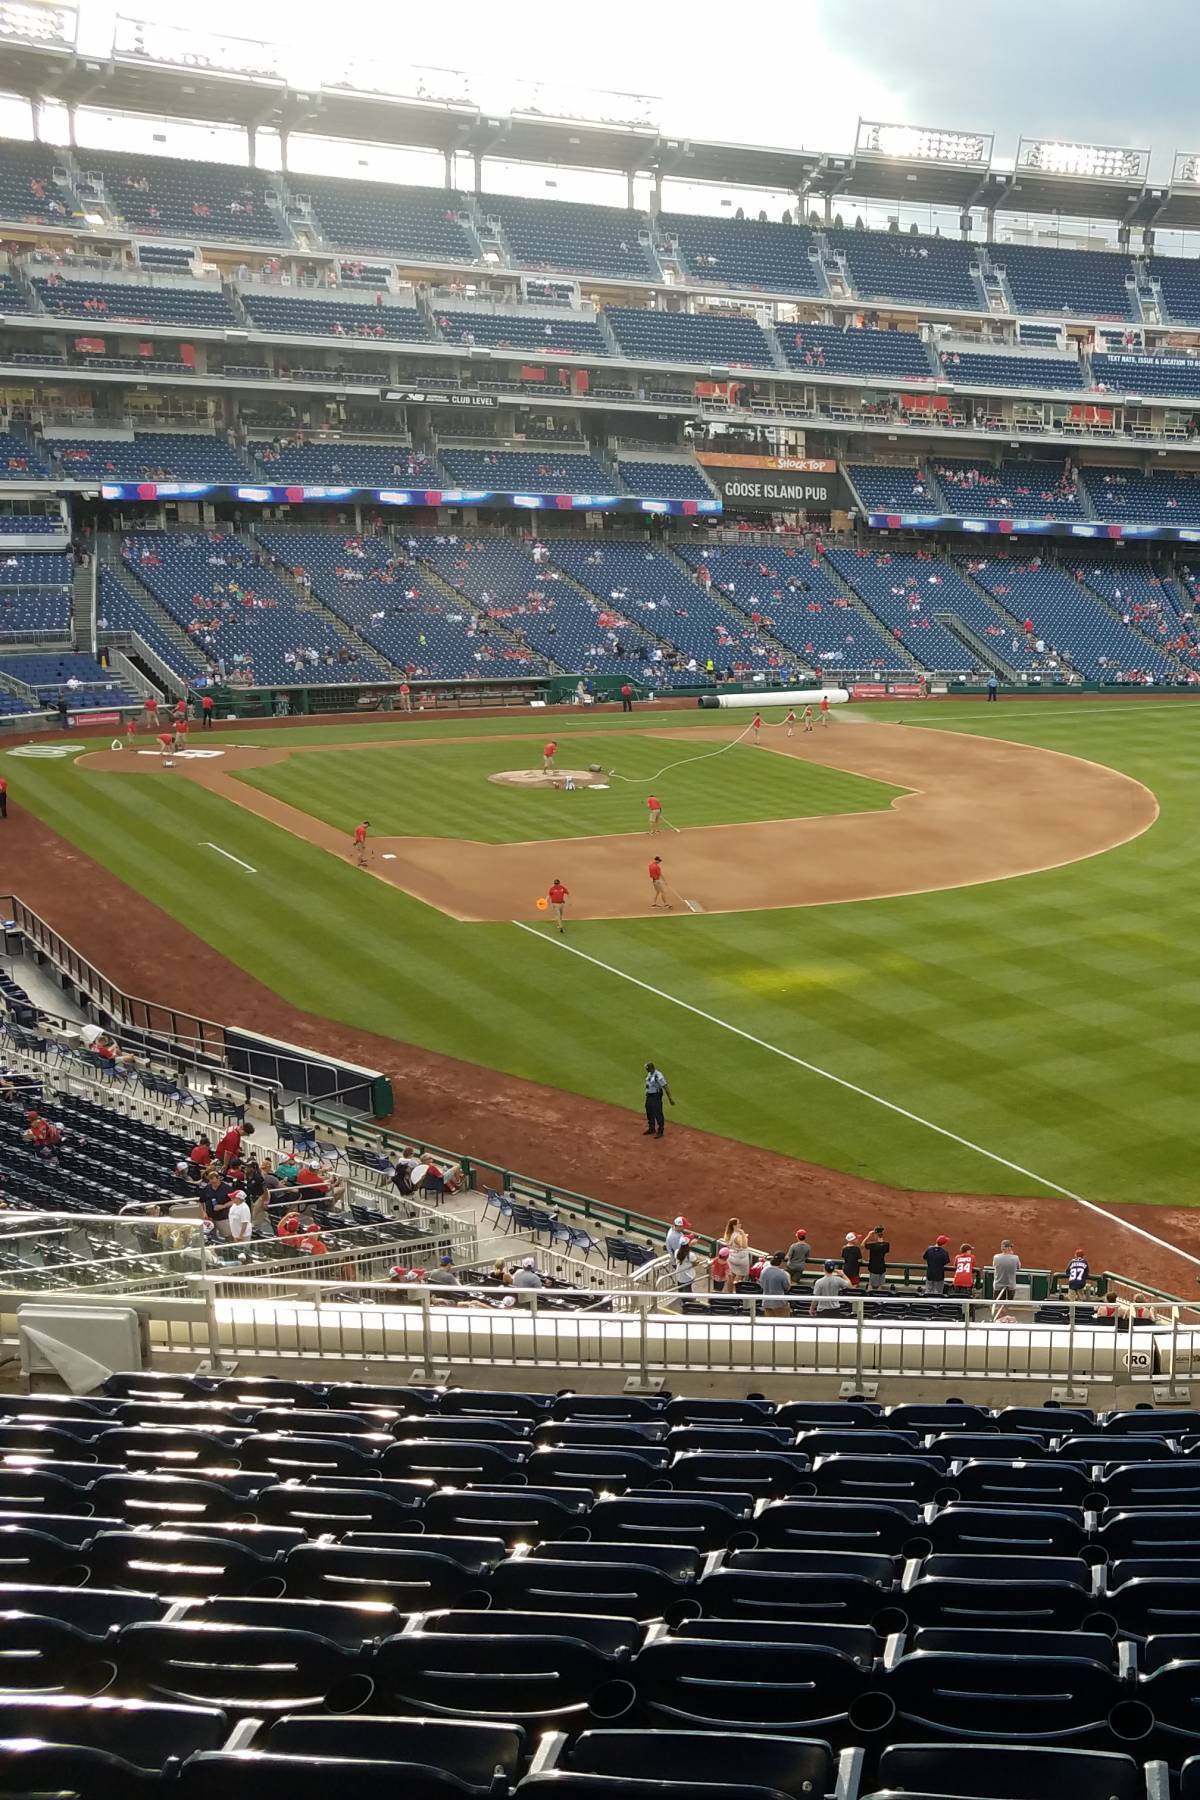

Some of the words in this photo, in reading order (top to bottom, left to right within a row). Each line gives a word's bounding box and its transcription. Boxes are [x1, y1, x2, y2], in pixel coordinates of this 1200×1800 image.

[451, 395, 471, 404] CLUB
[472, 397, 494, 406] LEVEL
[777, 457, 808, 469] SHOCK
[808, 460, 826, 471] TOP
[725, 482, 762, 497] GOOSE
[763, 484, 803, 500] ISLAND
[805, 486, 827, 501] PUB
[956, 1262, 971, 1273] 34
